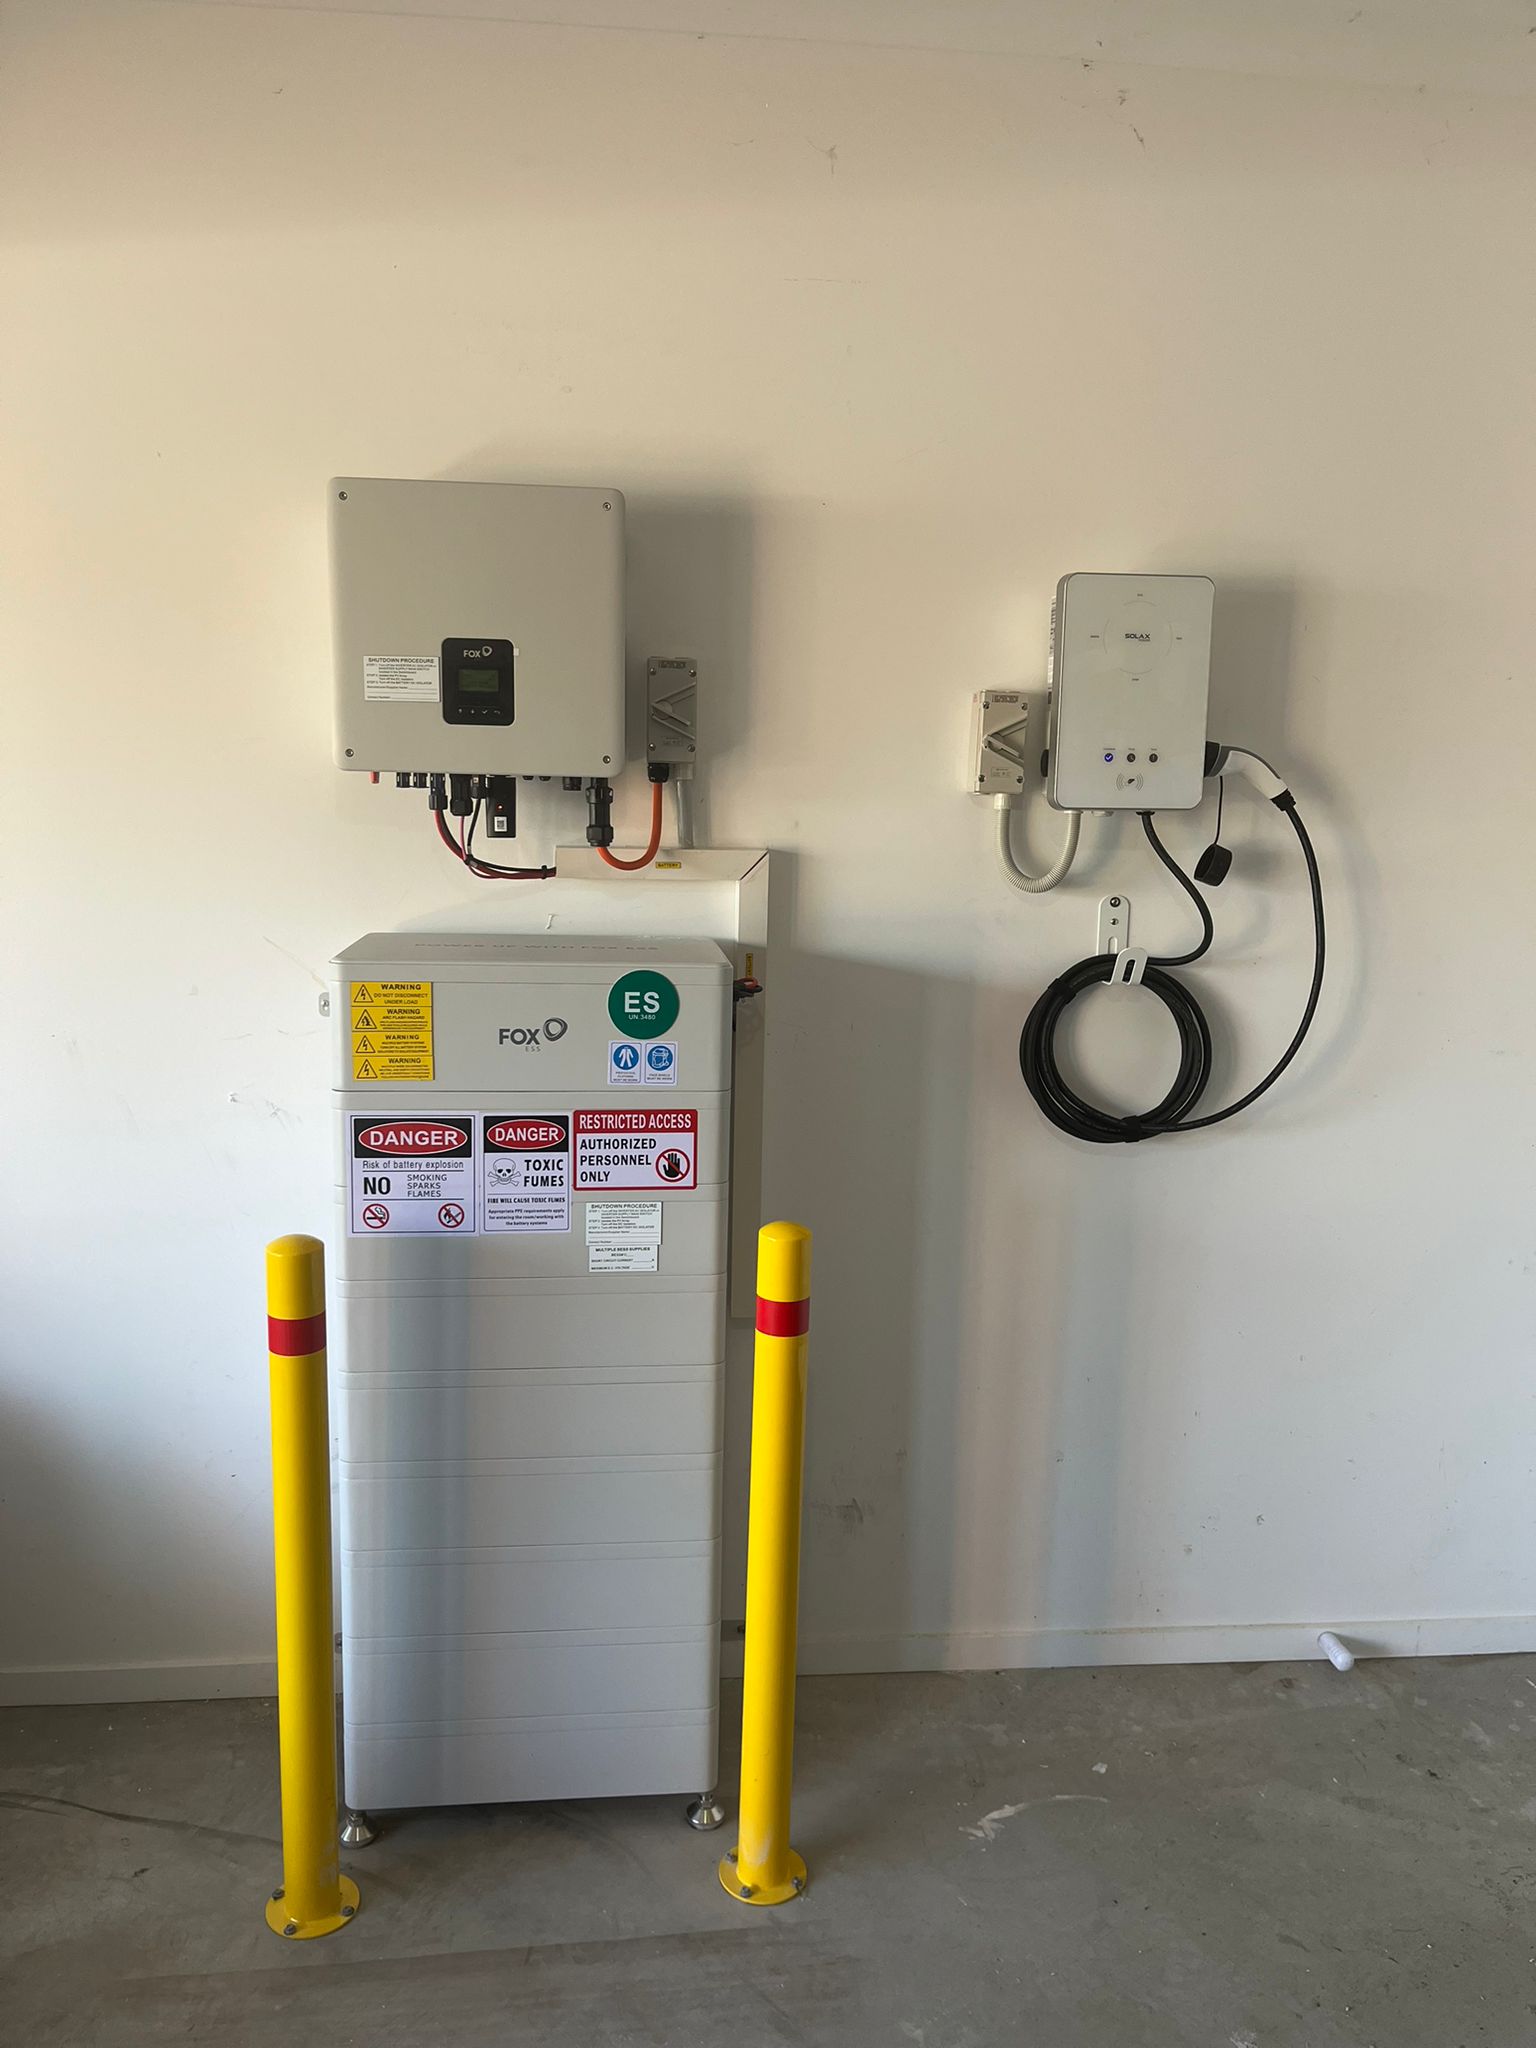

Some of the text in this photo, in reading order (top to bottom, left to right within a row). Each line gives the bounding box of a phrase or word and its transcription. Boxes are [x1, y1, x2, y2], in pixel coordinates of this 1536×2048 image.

[464, 650, 481, 658] FOX
[624, 992, 660, 1013] ES
[499, 1028, 540, 1045] FOX
[580, 1113, 691, 1129] RESTRICTED ACCESS
[370, 1131, 458, 1146] DANGER
[495, 1128, 559, 1141] DANGER
[580, 1138, 657, 1150] AUTHORIZED
[362, 1161, 464, 1170] Risk of battery explosion
[524, 1159, 563, 1171] TOXIC
[580, 1155, 652, 1166] PERSONNEL
[524, 1175, 564, 1187] FUMES
[580, 1171, 611, 1182] ONLY
[363, 1177, 391, 1195] NO
